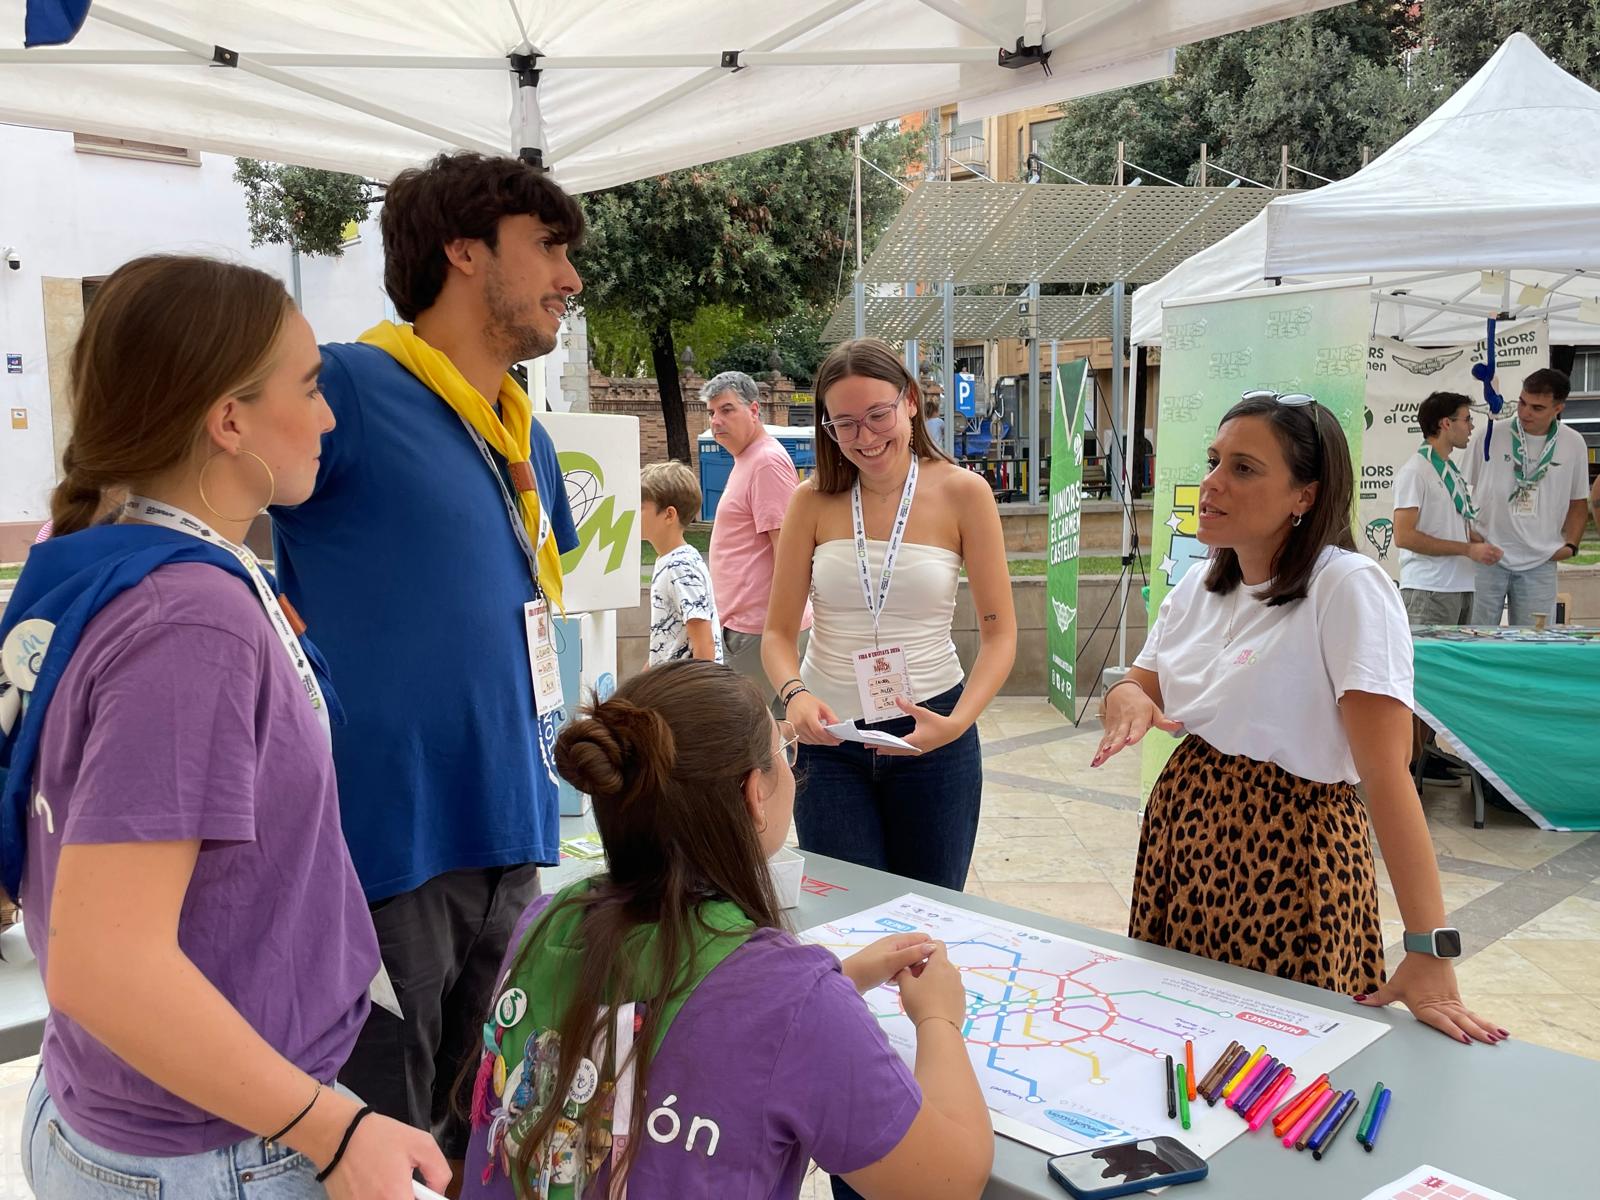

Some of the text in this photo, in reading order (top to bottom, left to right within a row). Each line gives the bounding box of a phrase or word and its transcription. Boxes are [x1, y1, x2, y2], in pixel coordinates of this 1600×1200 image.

[1495, 345, 1538, 357] armen
[959, 382, 970, 404] P
[1051, 480, 1080, 521] JUNIORS
[1051, 511, 1080, 544] EL CARMEN
